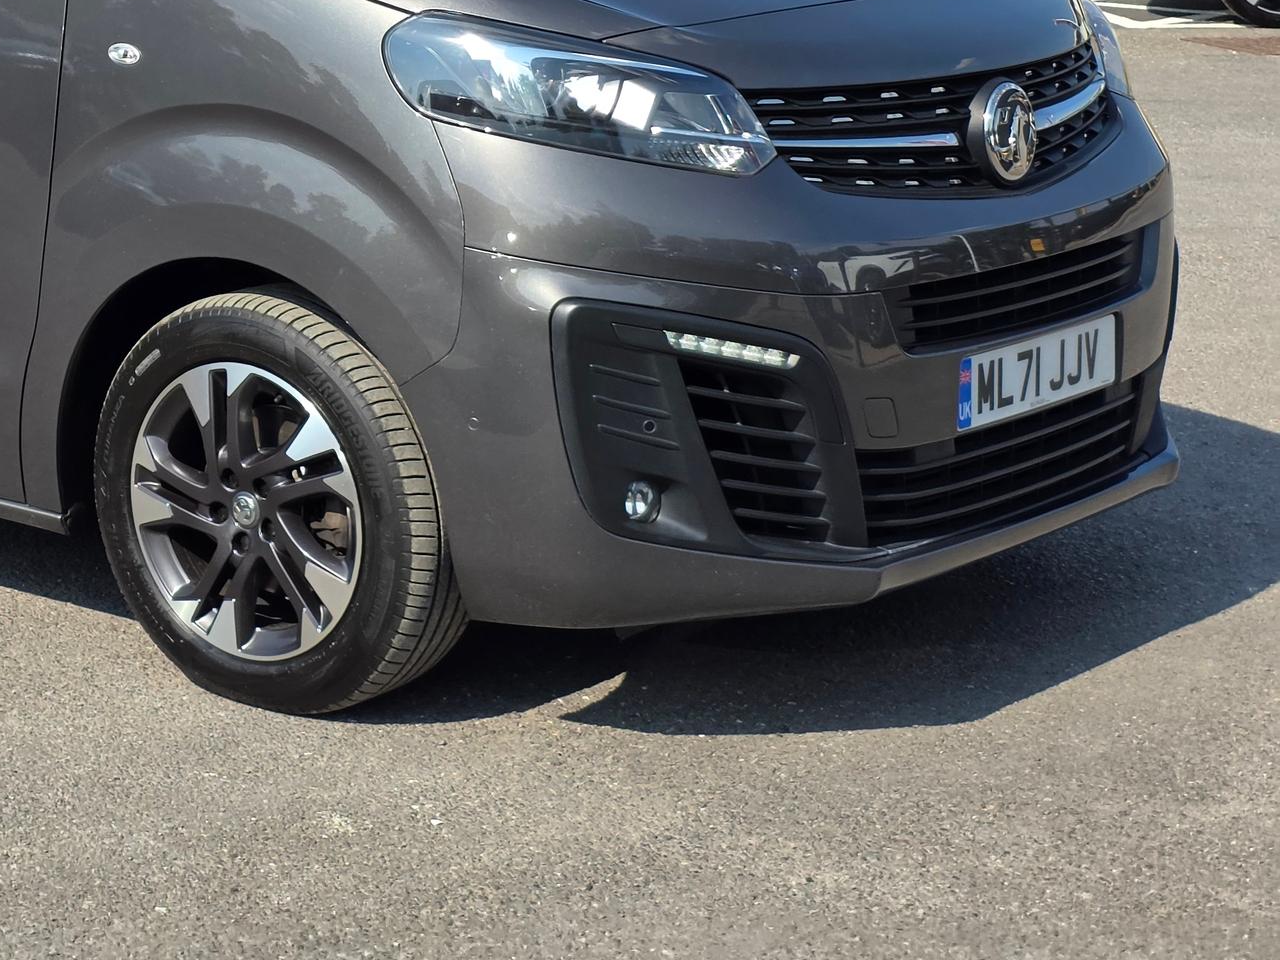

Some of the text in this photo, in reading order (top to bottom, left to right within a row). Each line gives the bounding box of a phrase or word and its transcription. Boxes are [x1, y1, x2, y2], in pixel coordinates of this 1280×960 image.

[976, 328, 1099, 415] ML71 JJV
[958, 400, 971, 421] UK
